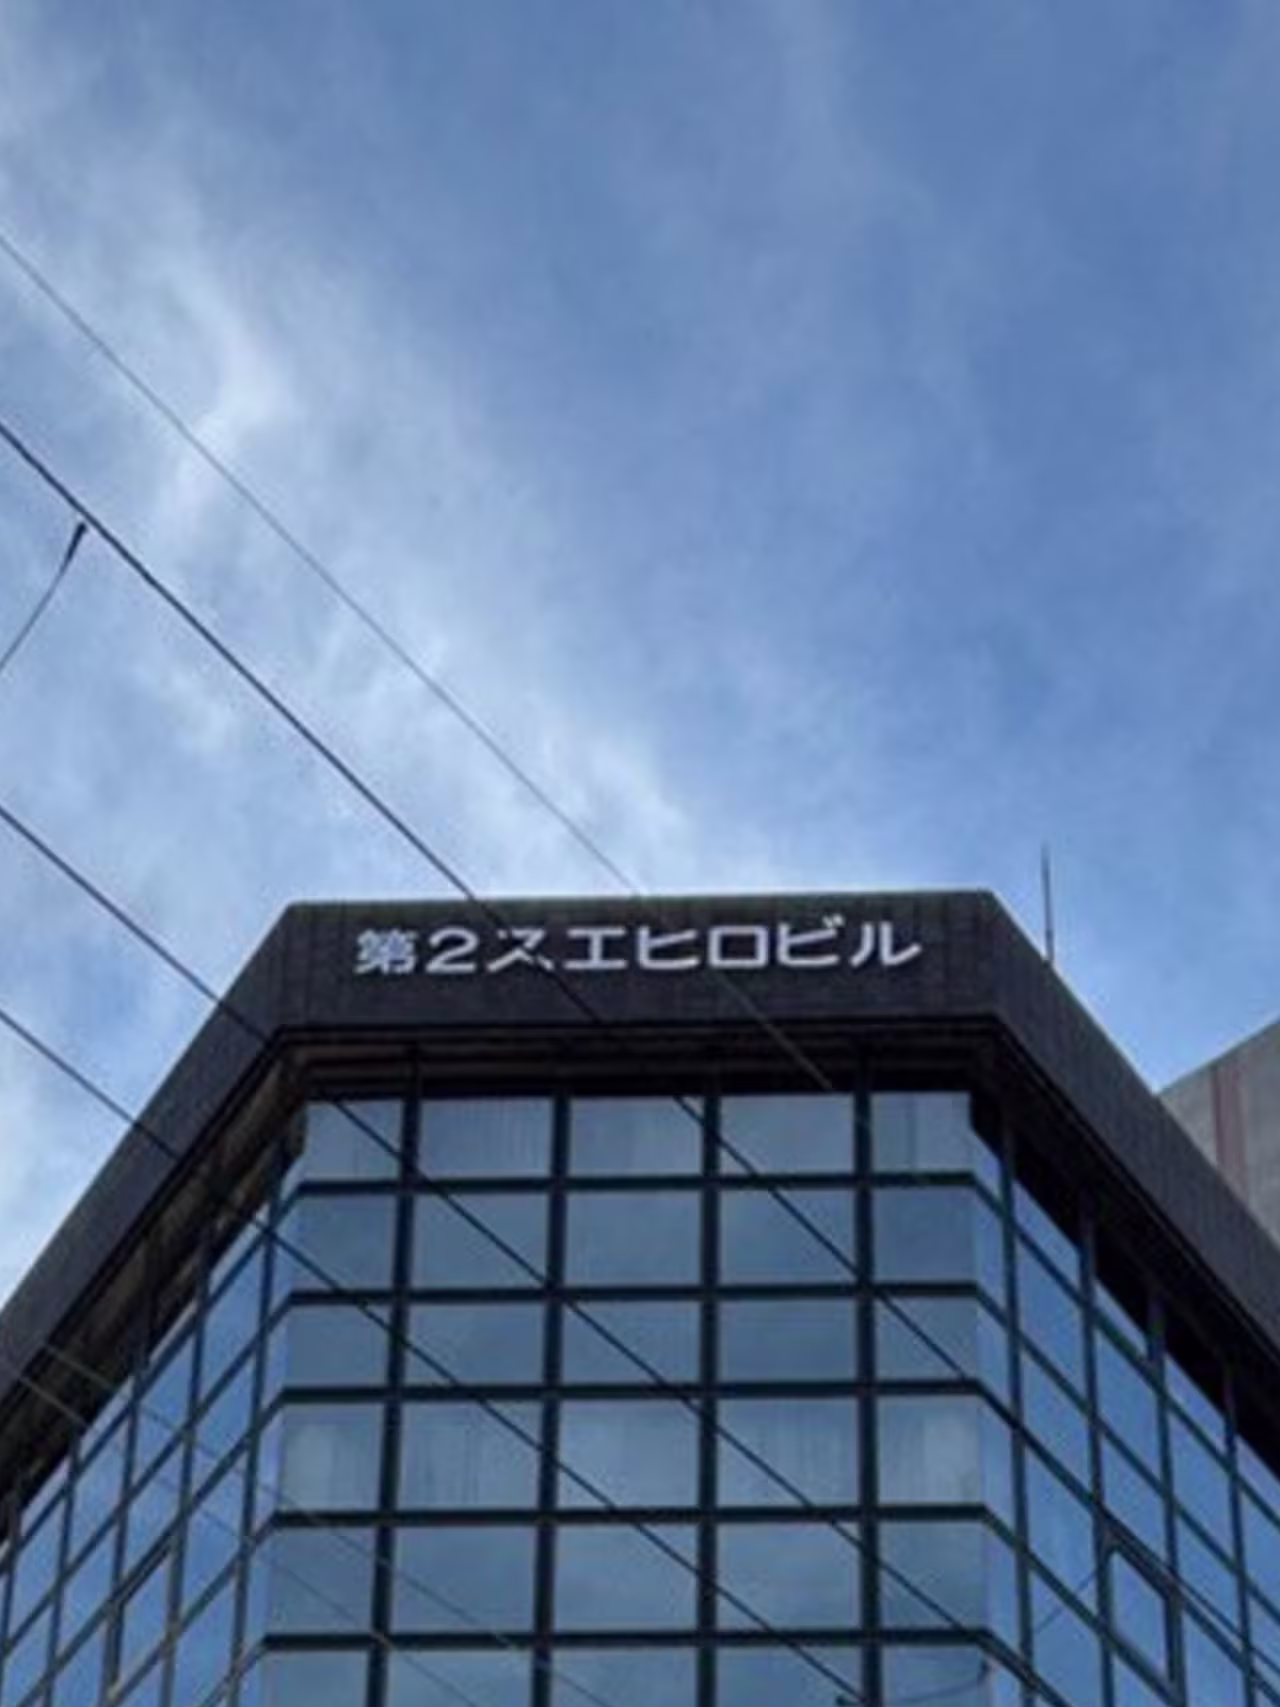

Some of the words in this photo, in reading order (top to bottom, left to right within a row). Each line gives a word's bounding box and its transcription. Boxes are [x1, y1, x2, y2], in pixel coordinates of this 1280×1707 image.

[352, 913, 922, 974] 第2スエヒロビル
